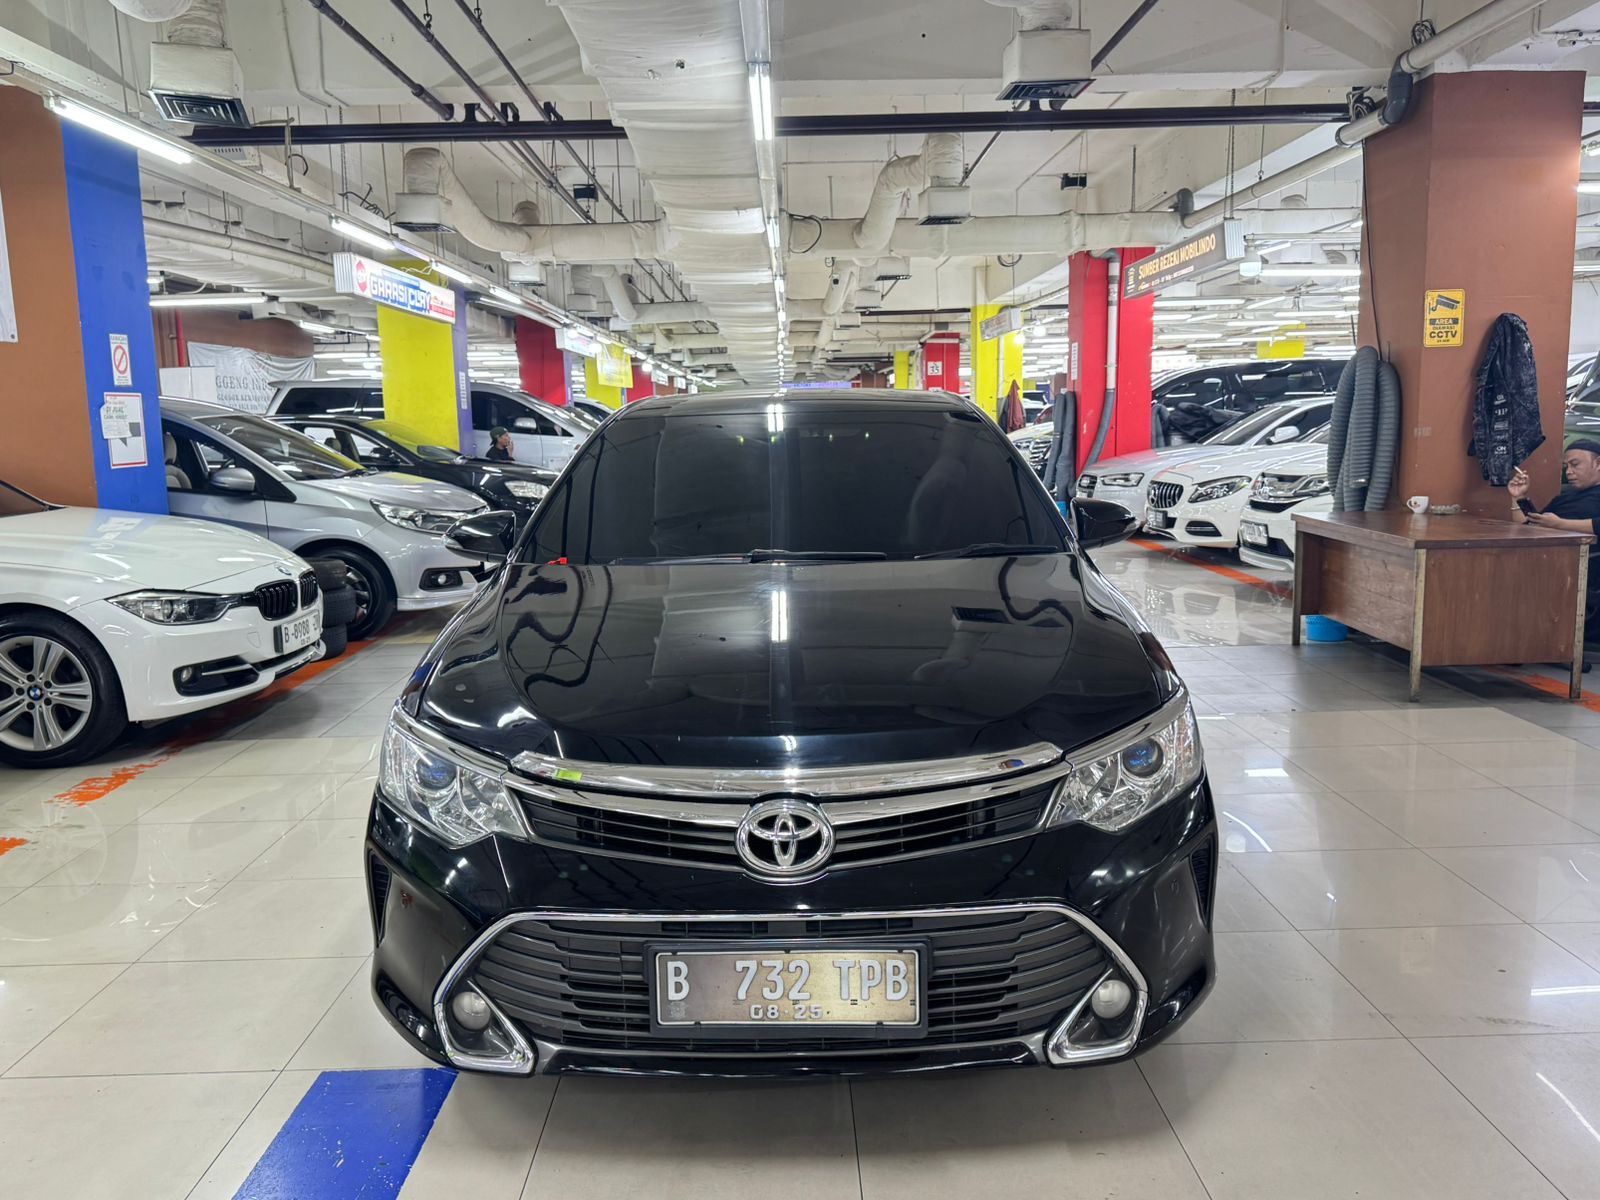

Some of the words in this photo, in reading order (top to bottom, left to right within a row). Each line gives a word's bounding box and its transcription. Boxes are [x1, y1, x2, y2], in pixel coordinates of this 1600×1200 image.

[1138, 258, 1160, 280] SUMBER
[1160, 248, 1180, 271] REZEKI
[1180, 233, 1216, 264] MOBILINDO
[1429, 330, 1458, 339] CCTV
[667, 960, 690, 1001] B
[735, 960, 811, 1001] 732
[833, 959, 910, 1001] TPB
